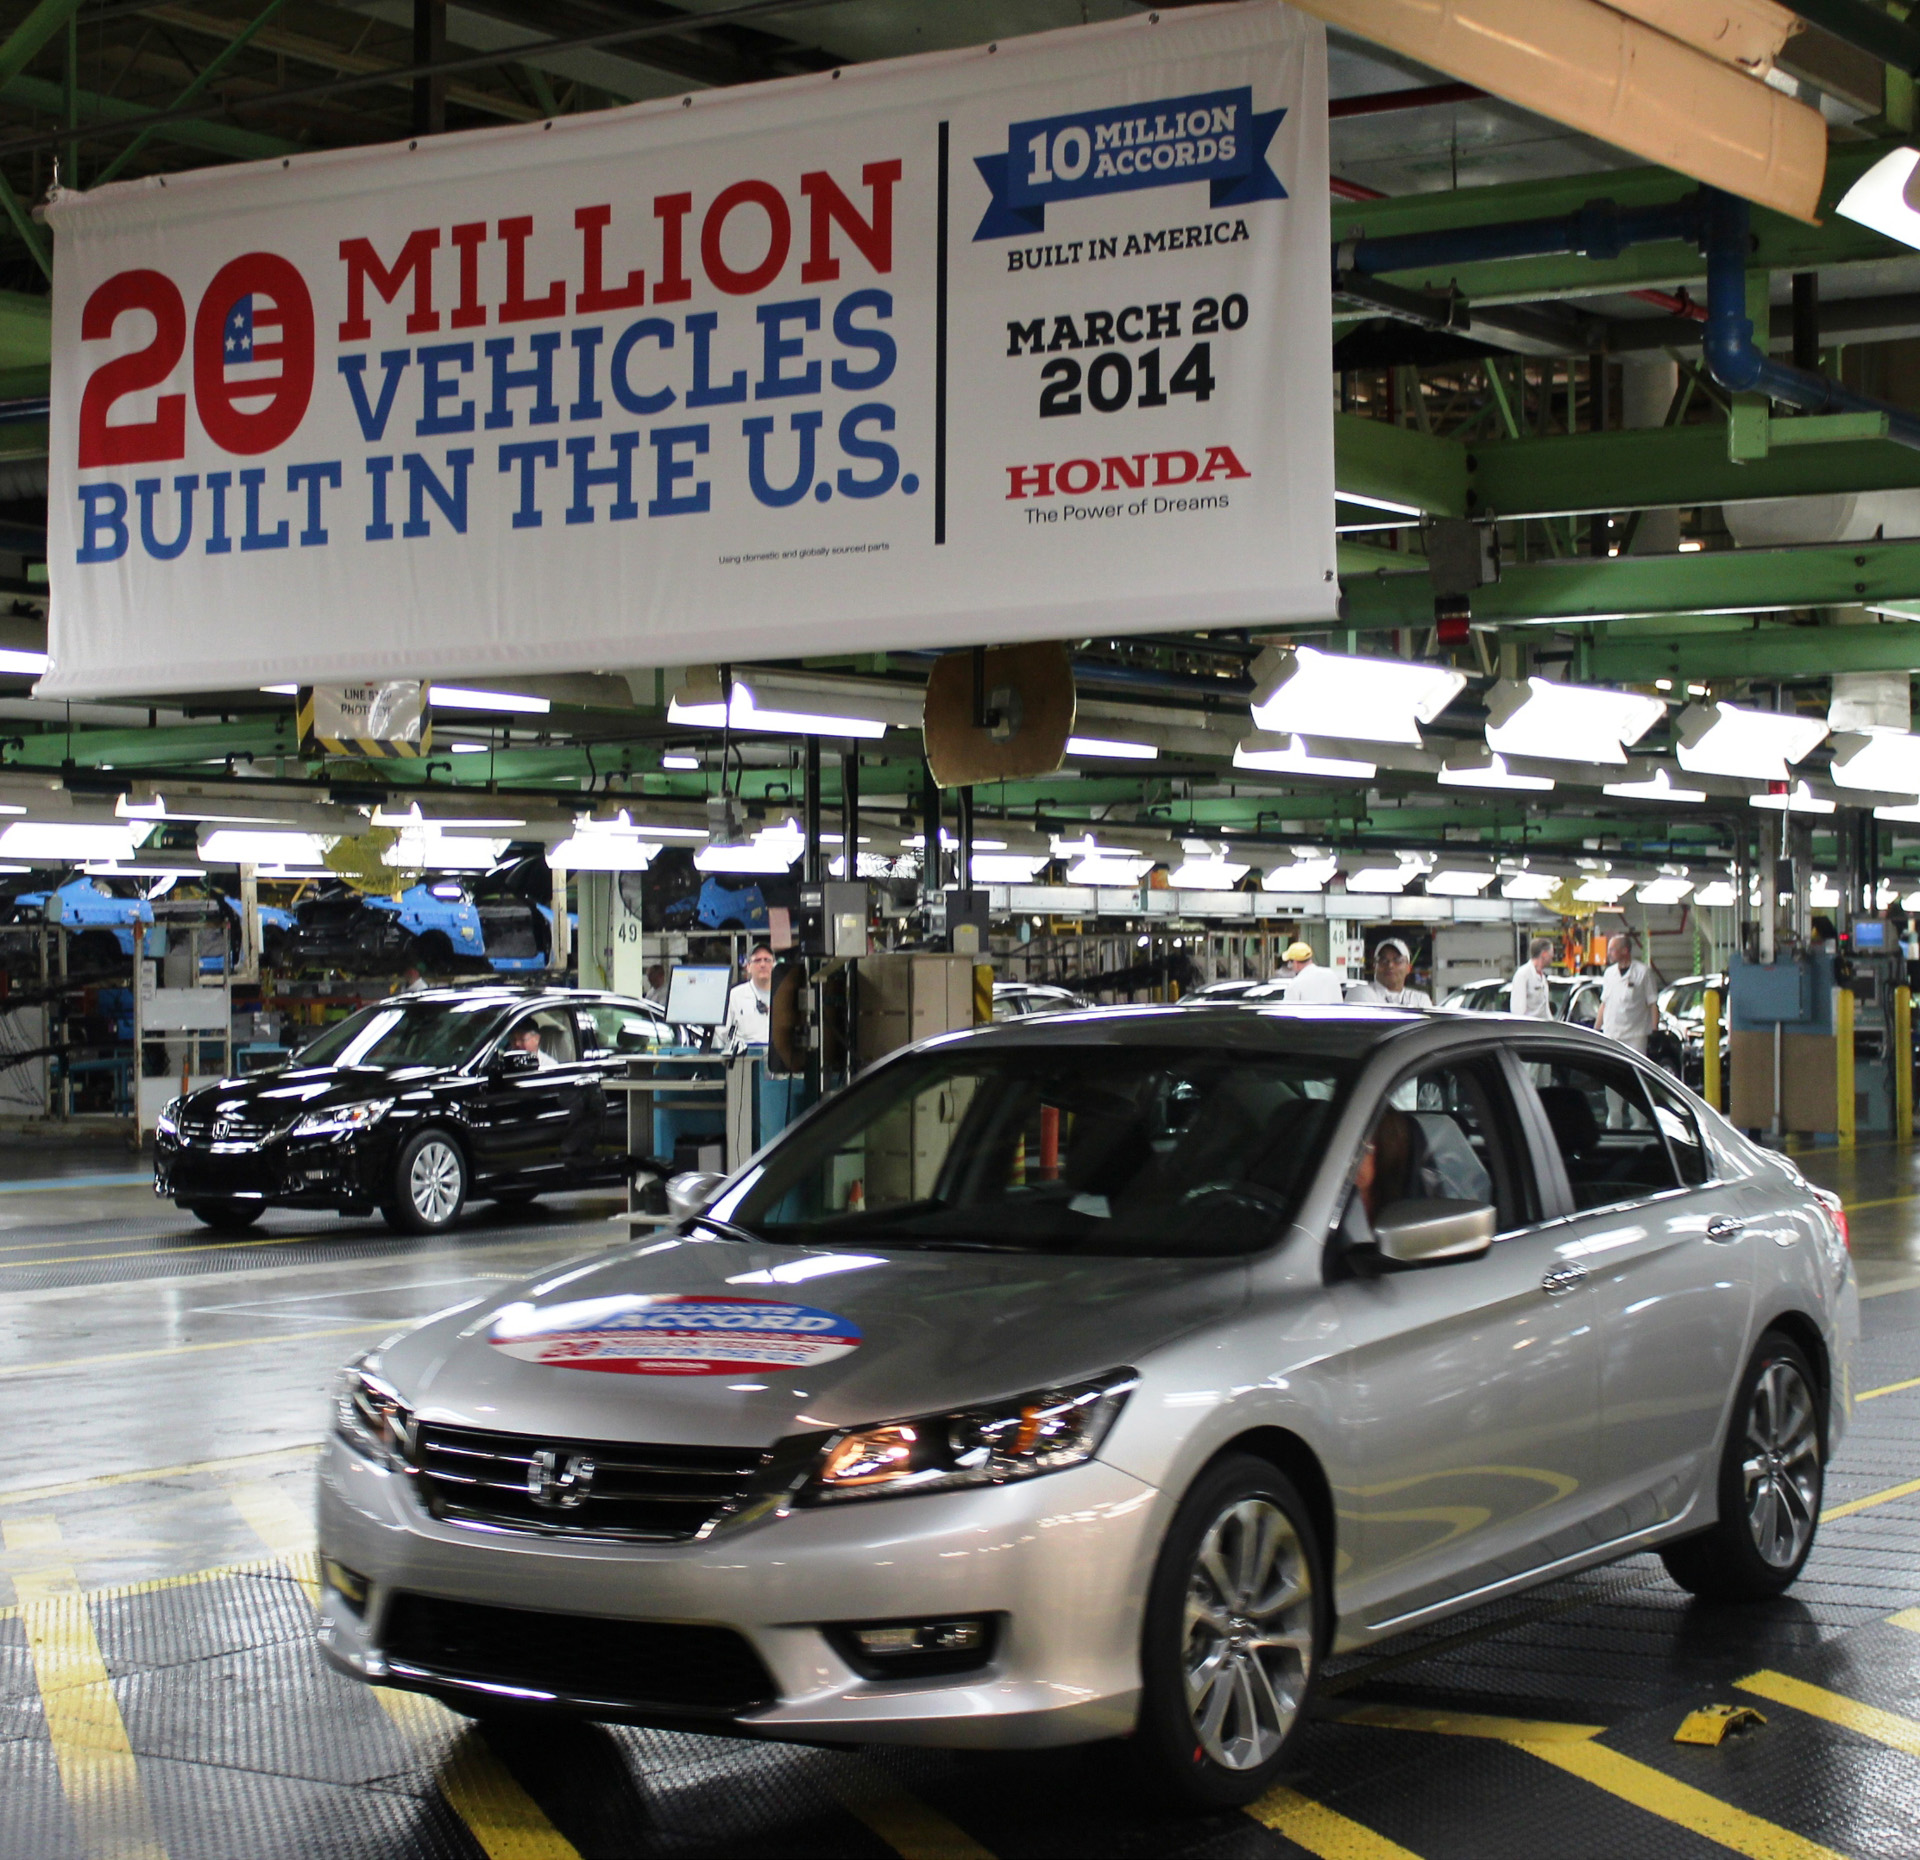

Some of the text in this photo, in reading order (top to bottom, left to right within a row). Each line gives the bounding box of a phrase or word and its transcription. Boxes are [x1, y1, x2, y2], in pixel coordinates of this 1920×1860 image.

[1094, 104, 1238, 151] MILLION
[1027, 126, 1091, 185] 10
[1093, 135, 1237, 179] ACCORDS
[338, 158, 902, 342] MILLION
[1007, 219, 1250, 272] BUILT IN AMERICA
[1006, 293, 1249, 358] MARCH 20
[78, 252, 315, 469] 20
[337, 288, 898, 441] VEHICLES
[1039, 341, 1216, 418] 2014
[76, 402, 920, 564] BUILT IN THE U.S.
[1005, 445, 1252, 500] HONDA
[1024, 494, 1230, 525] The Power of Dreams
[718, 541, 890, 565] Using domestic and globally sourced parts
[344, 688, 392, 702] LINE SP
[619, 923, 637, 942] 49
[1332, 930, 1345, 944] 48
[600, 1312, 838, 1331] ACCORD
